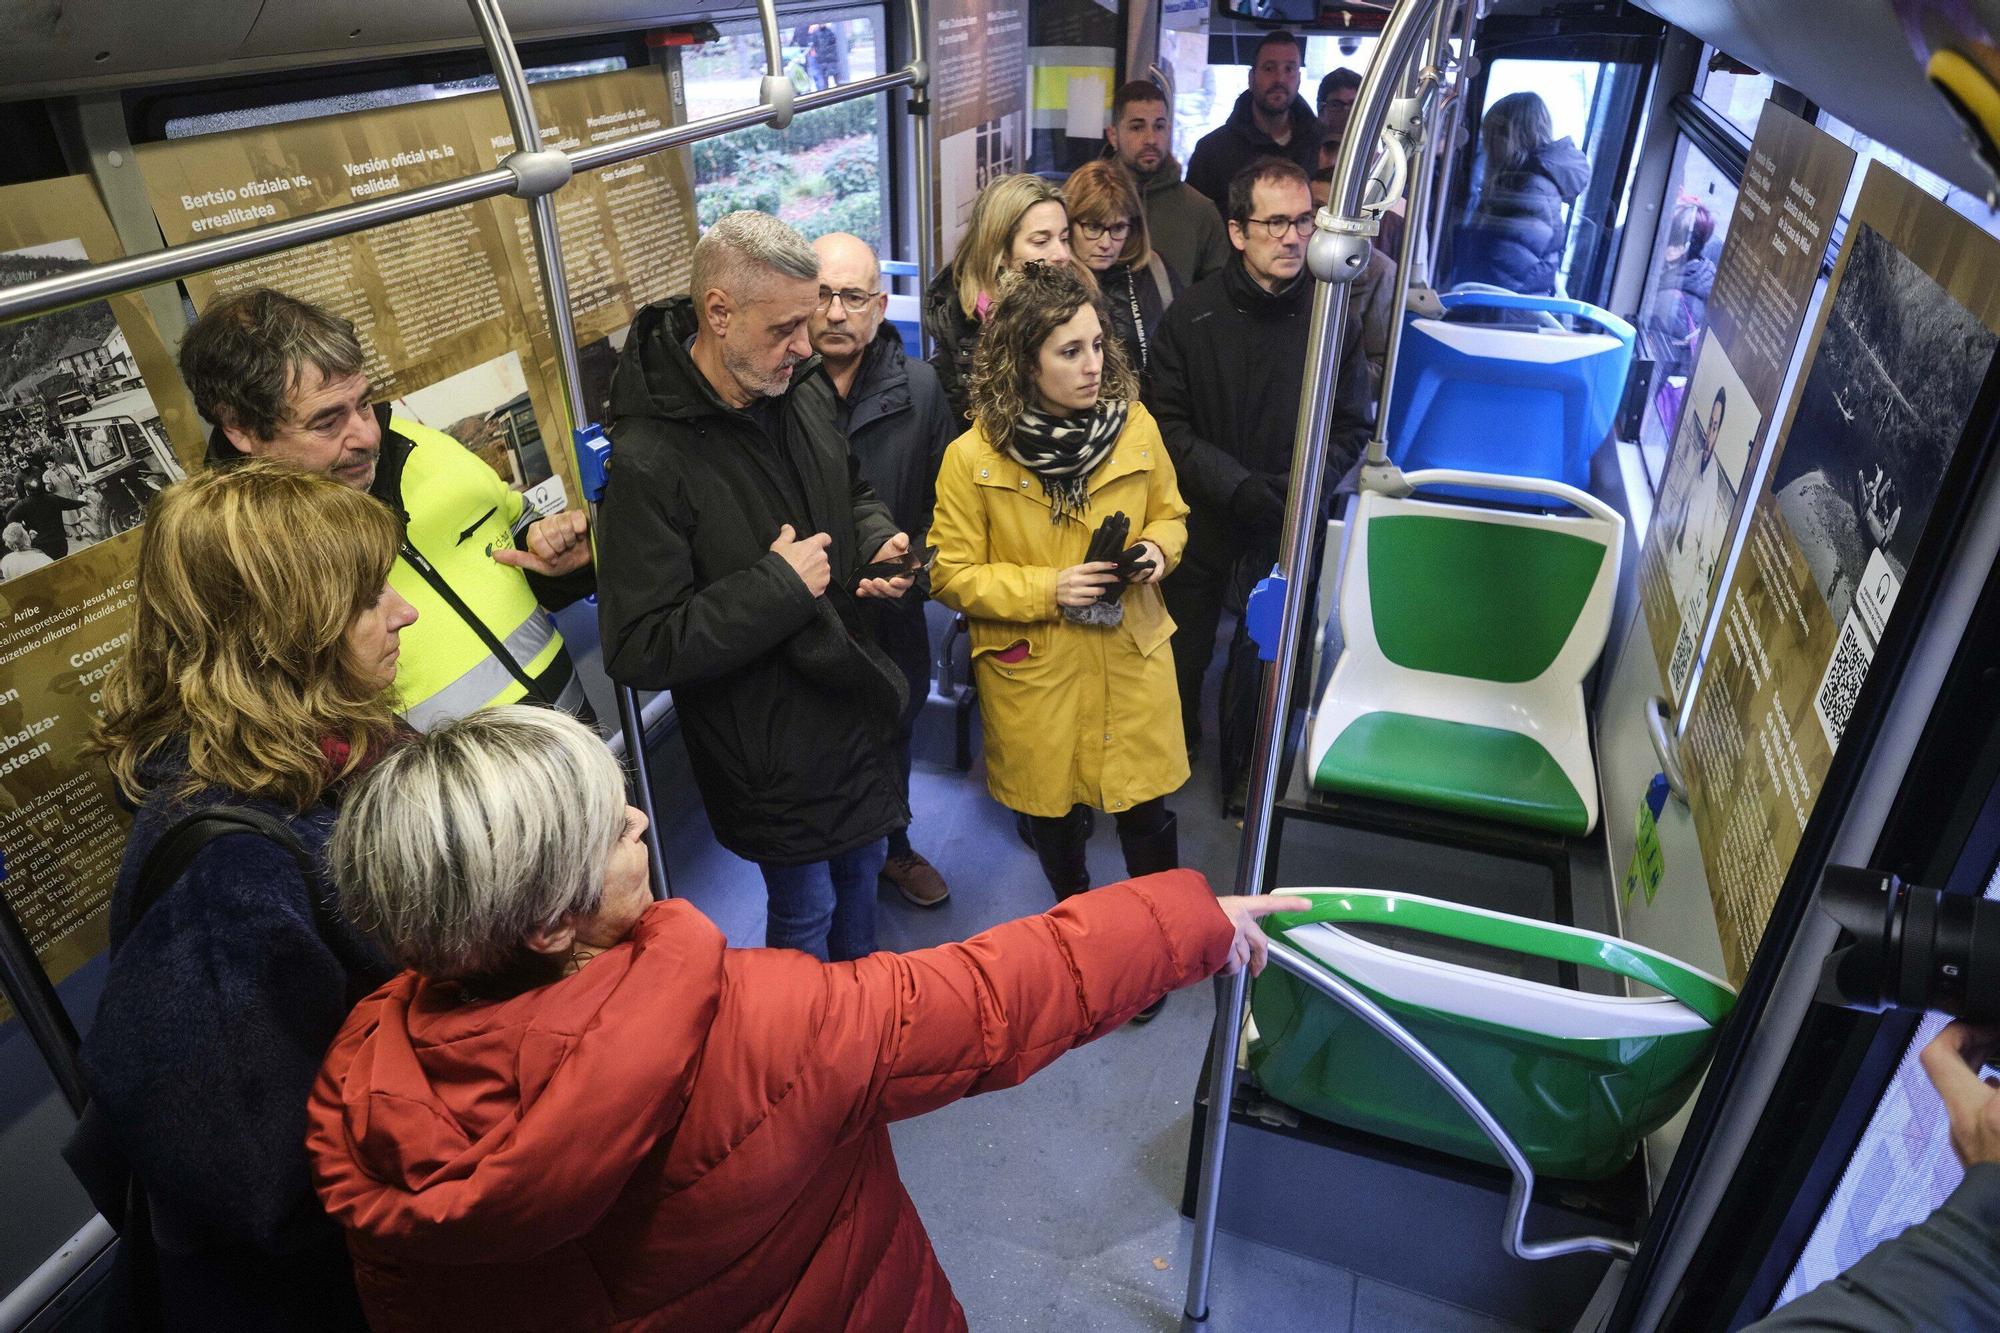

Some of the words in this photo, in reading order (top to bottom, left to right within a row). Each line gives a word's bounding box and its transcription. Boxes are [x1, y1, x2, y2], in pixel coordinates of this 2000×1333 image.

[342, 157, 390, 177] Versión
[391, 149, 426, 168] oficial
[426, 148, 443, 160] vs.
[442, 144, 455, 157] la
[181, 188, 237, 211] Bertsio
[239, 177, 291, 199] ofiziala
[291, 175, 313, 188] vs.
[350, 174, 400, 197] realidad
[191, 203, 276, 232] errealitatea
[14, 606, 40, 623] Aribe
[82, 592, 106, 609] Jesus
[43, 622, 77, 645] alkatea
[84, 605, 116, 625] Alcalde
[117, 599, 128, 609] de
[1766, 710, 1774, 730] de
[1771, 723, 1785, 761] Mikel
[1781, 753, 1799, 810] Zabalza
[1773, 690, 1791, 742] Sacando
[1794, 752, 1811, 801] cuerpo
[5, 801, 35, 823] Mikel
[35, 770, 92, 806] Zabalzaren
[26, 804, 63, 827] ostean,
[65, 781, 97, 804] Ariben
[43, 818, 60, 831] eta
[69, 792, 103, 815] autoen
[4, 837, 54, 870] erakusten
[62, 822, 76, 835] du
[78, 804, 108, 824] argaz-
[30, 853, 51, 871] gisa
[54, 814, 114, 854] antolatutako
[32, 848, 82, 882] familiaren
[89, 824, 120, 847] etxetik
[24, 902, 46, 918] zen.
[46, 869, 93, 902] Etsipenez
[96, 858, 111, 871] eta
[35, 908, 57, 927] goiz
[62, 886, 91, 907] baten
[51, 907, 79, 929] zuten
[51, 919, 85, 943] aukera
